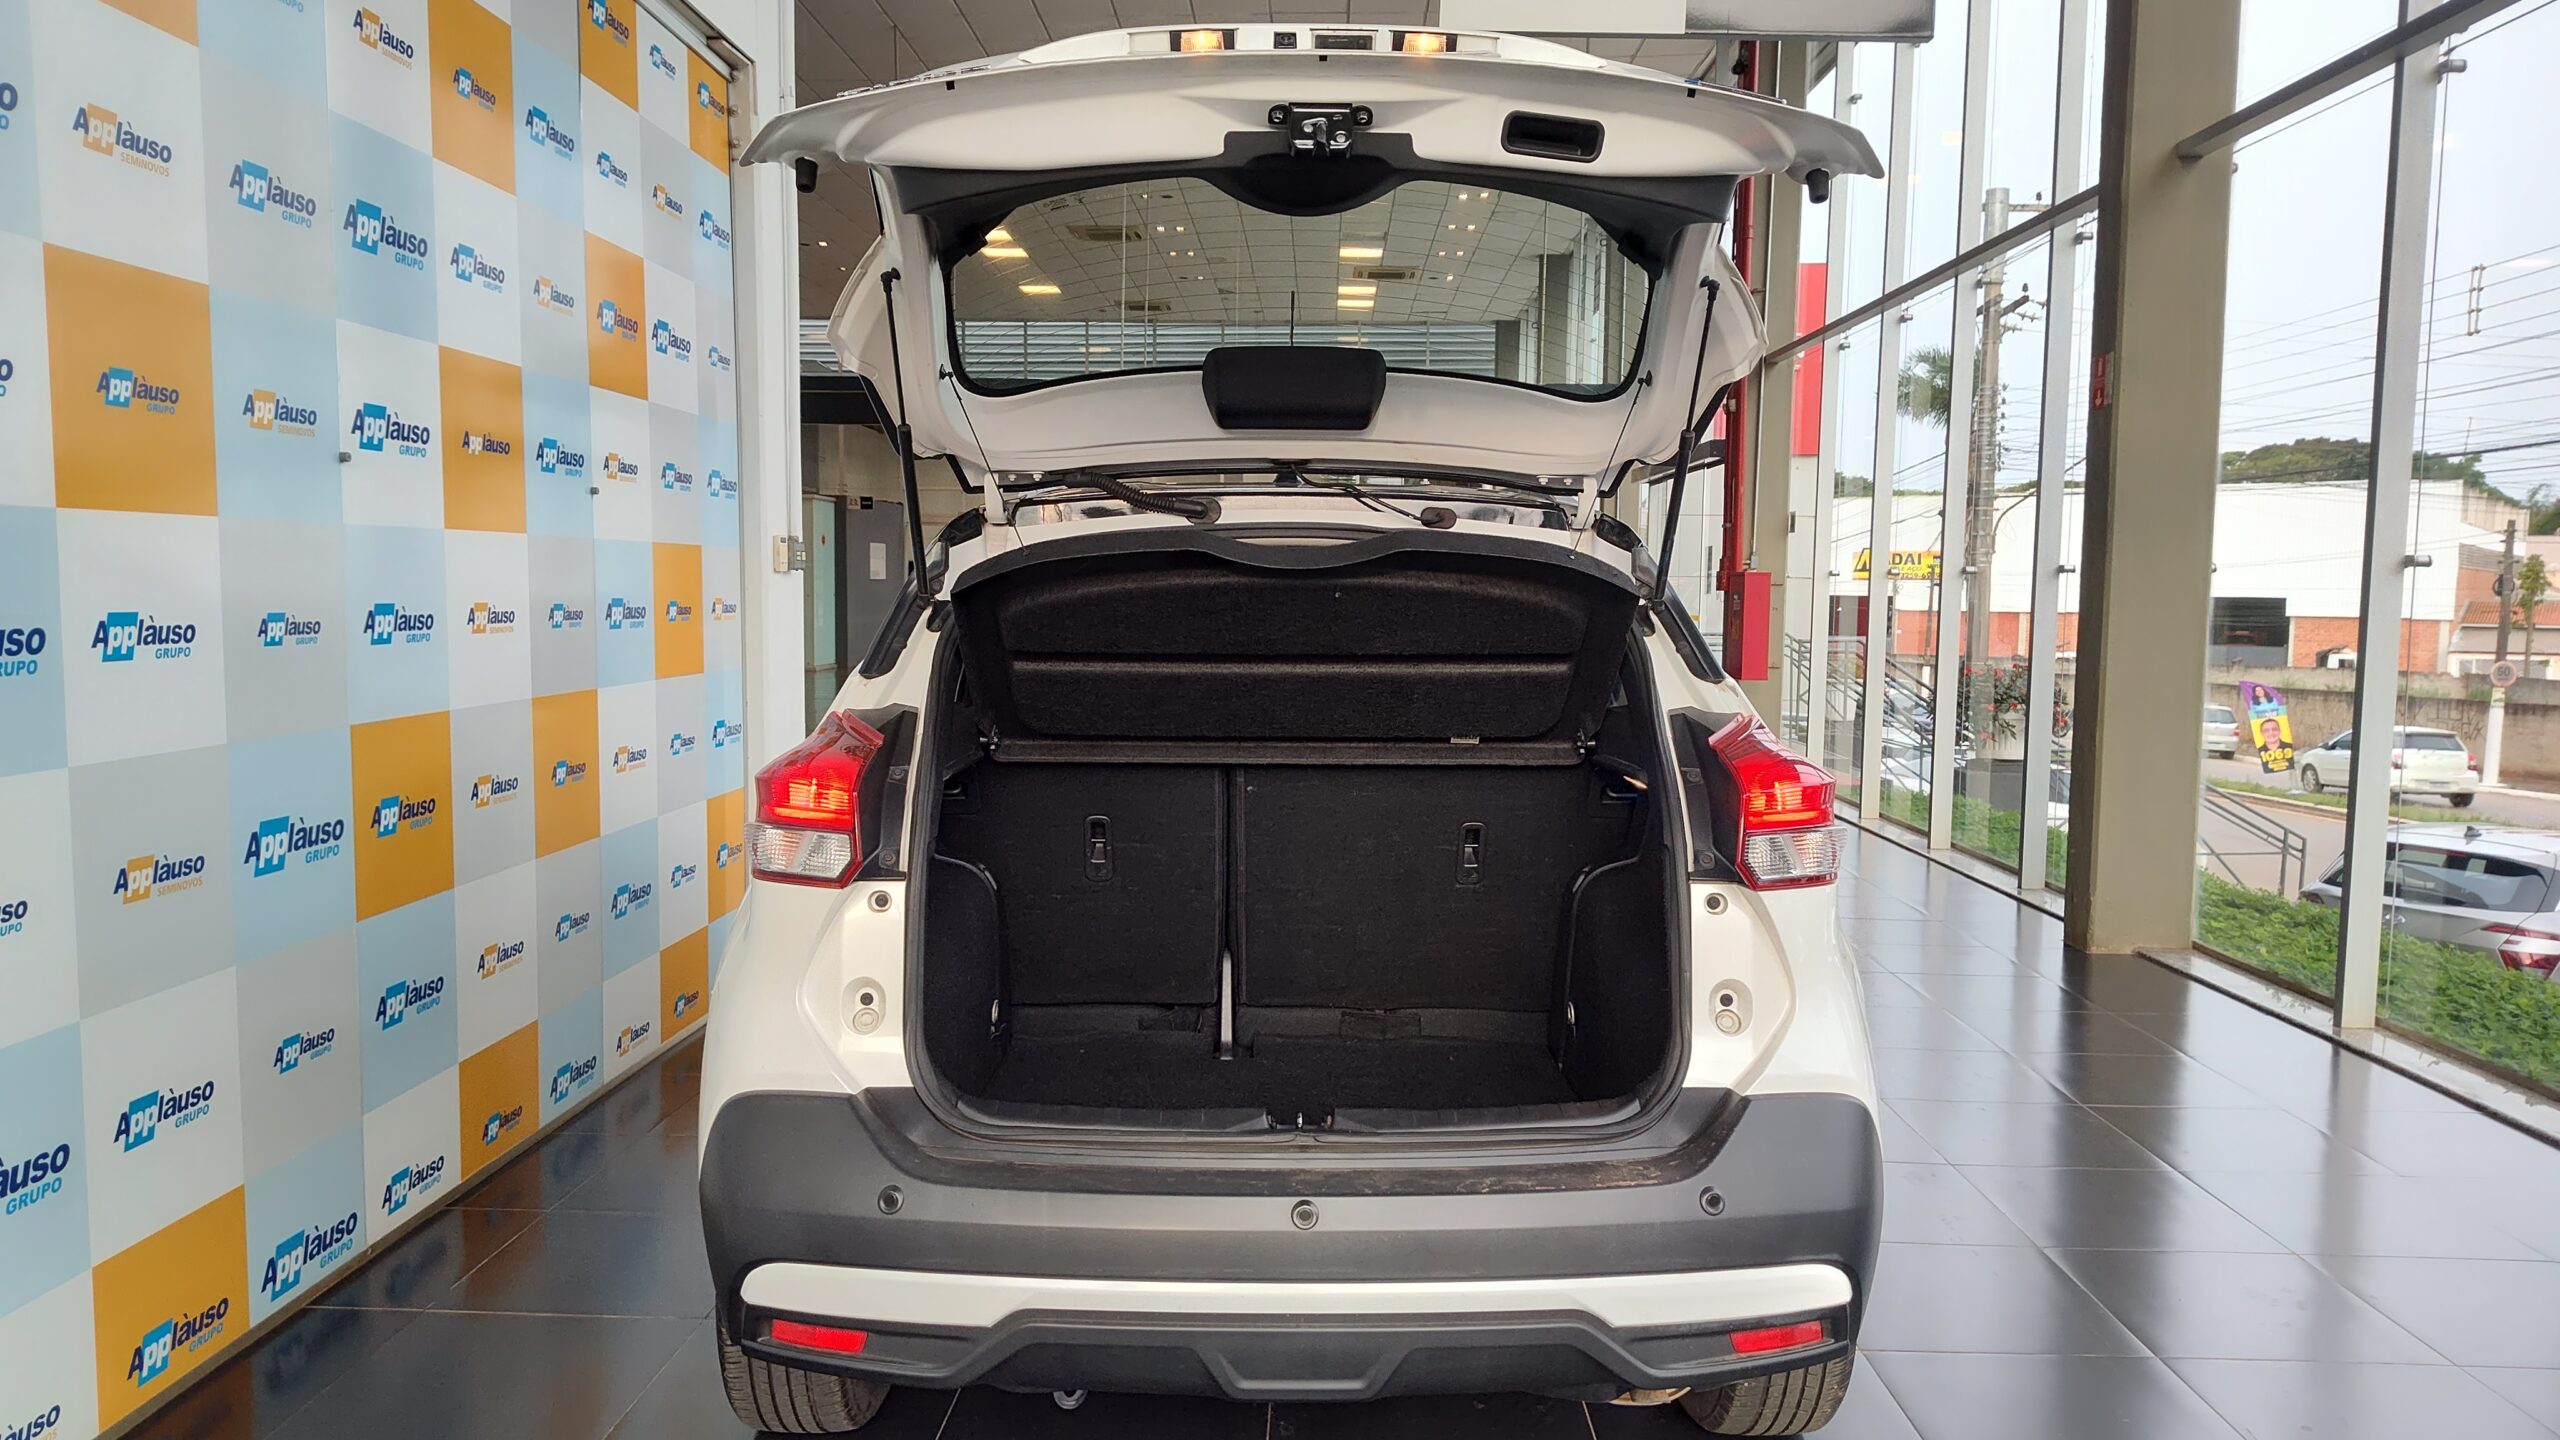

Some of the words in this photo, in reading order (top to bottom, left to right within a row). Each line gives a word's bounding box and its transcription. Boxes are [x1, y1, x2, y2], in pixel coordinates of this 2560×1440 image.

[353, 10, 413, 59] Applàuso
[72, 106, 172, 164] Applàuso
[120, 152, 170, 177] SEMINOVOS
[229, 164, 316, 217] Applàuso
[282, 210, 312, 228] GRUPO
[343, 204, 428, 258] Applàuso
[394, 252, 424, 271] GRUPO
[96, 372, 180, 405] Applàuso
[146, 402, 175, 415] GRUPO
[243, 394, 317, 426] Applàuso
[351, 409, 430, 446] Applàuso
[462, 431, 510, 455] Applàuso
[399, 444, 426, 458] GRUPO
[536, 442, 584, 468] Applàuso
[91, 615, 196, 654] Applàuso
[257, 616, 321, 641] Applàuso
[363, 607, 434, 638] Applàuso
[406, 633, 431, 643] GRUPO
[155, 647, 191, 659] GRUPO
[471, 775, 518, 803] Applàuso
[370, 796, 436, 831] Applàuso
[244, 818, 344, 869] Applàuso
[305, 844, 340, 864] GRUPO
[113, 855, 205, 897] Applàuso
[157, 876, 203, 897] SEMINOVOS
[0, 922, 22, 937] UPO
[375, 976, 444, 1024] Applàuso
[416, 996, 440, 1014] GRUPO
[273, 1028, 335, 1069] Applàuso
[113, 1080, 215, 1144] Applàuso
[174, 1104, 210, 1128] GRUPO
[6, 1176, 62, 1215] GRUPO
[381, 1155, 445, 1210] Applàuso
[261, 1211, 358, 1294] Applàuso
[319, 1237, 353, 1269] GRUPO
[127, 1297, 229, 1381] Applàuso
[189, 1322, 224, 1352] GRUPO
